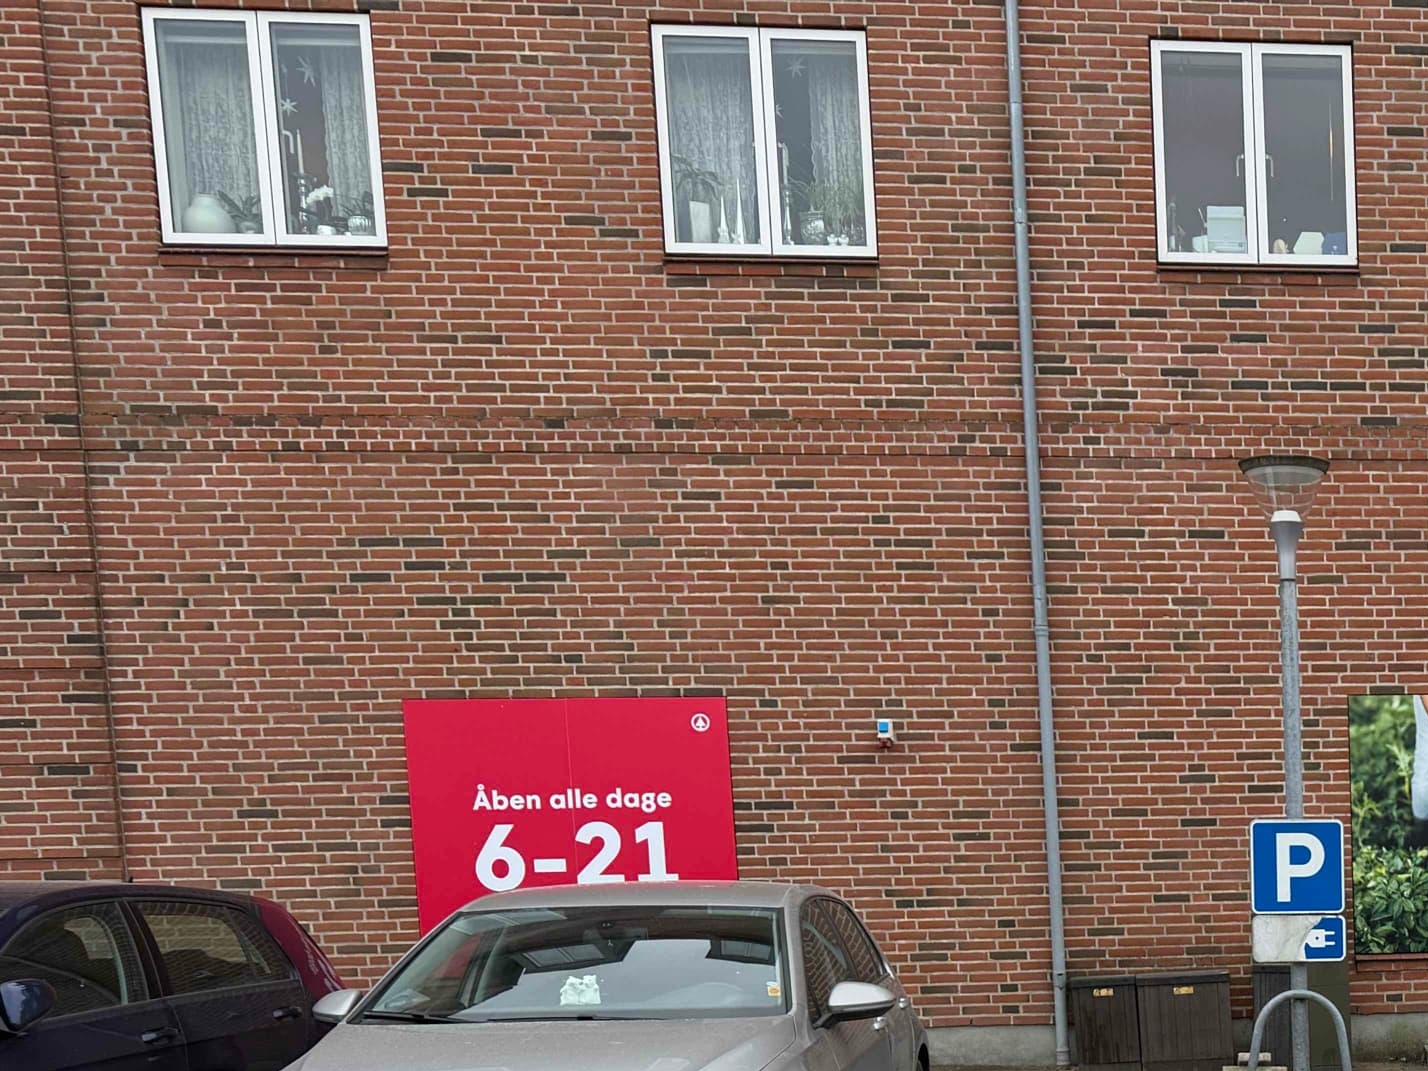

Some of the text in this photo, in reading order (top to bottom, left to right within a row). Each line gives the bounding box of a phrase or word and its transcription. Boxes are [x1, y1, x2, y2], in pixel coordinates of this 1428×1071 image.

[473, 783, 673, 813] Åben alle dage
[475, 821, 679, 892] 6-21
[1276, 832, 1325, 902] P
